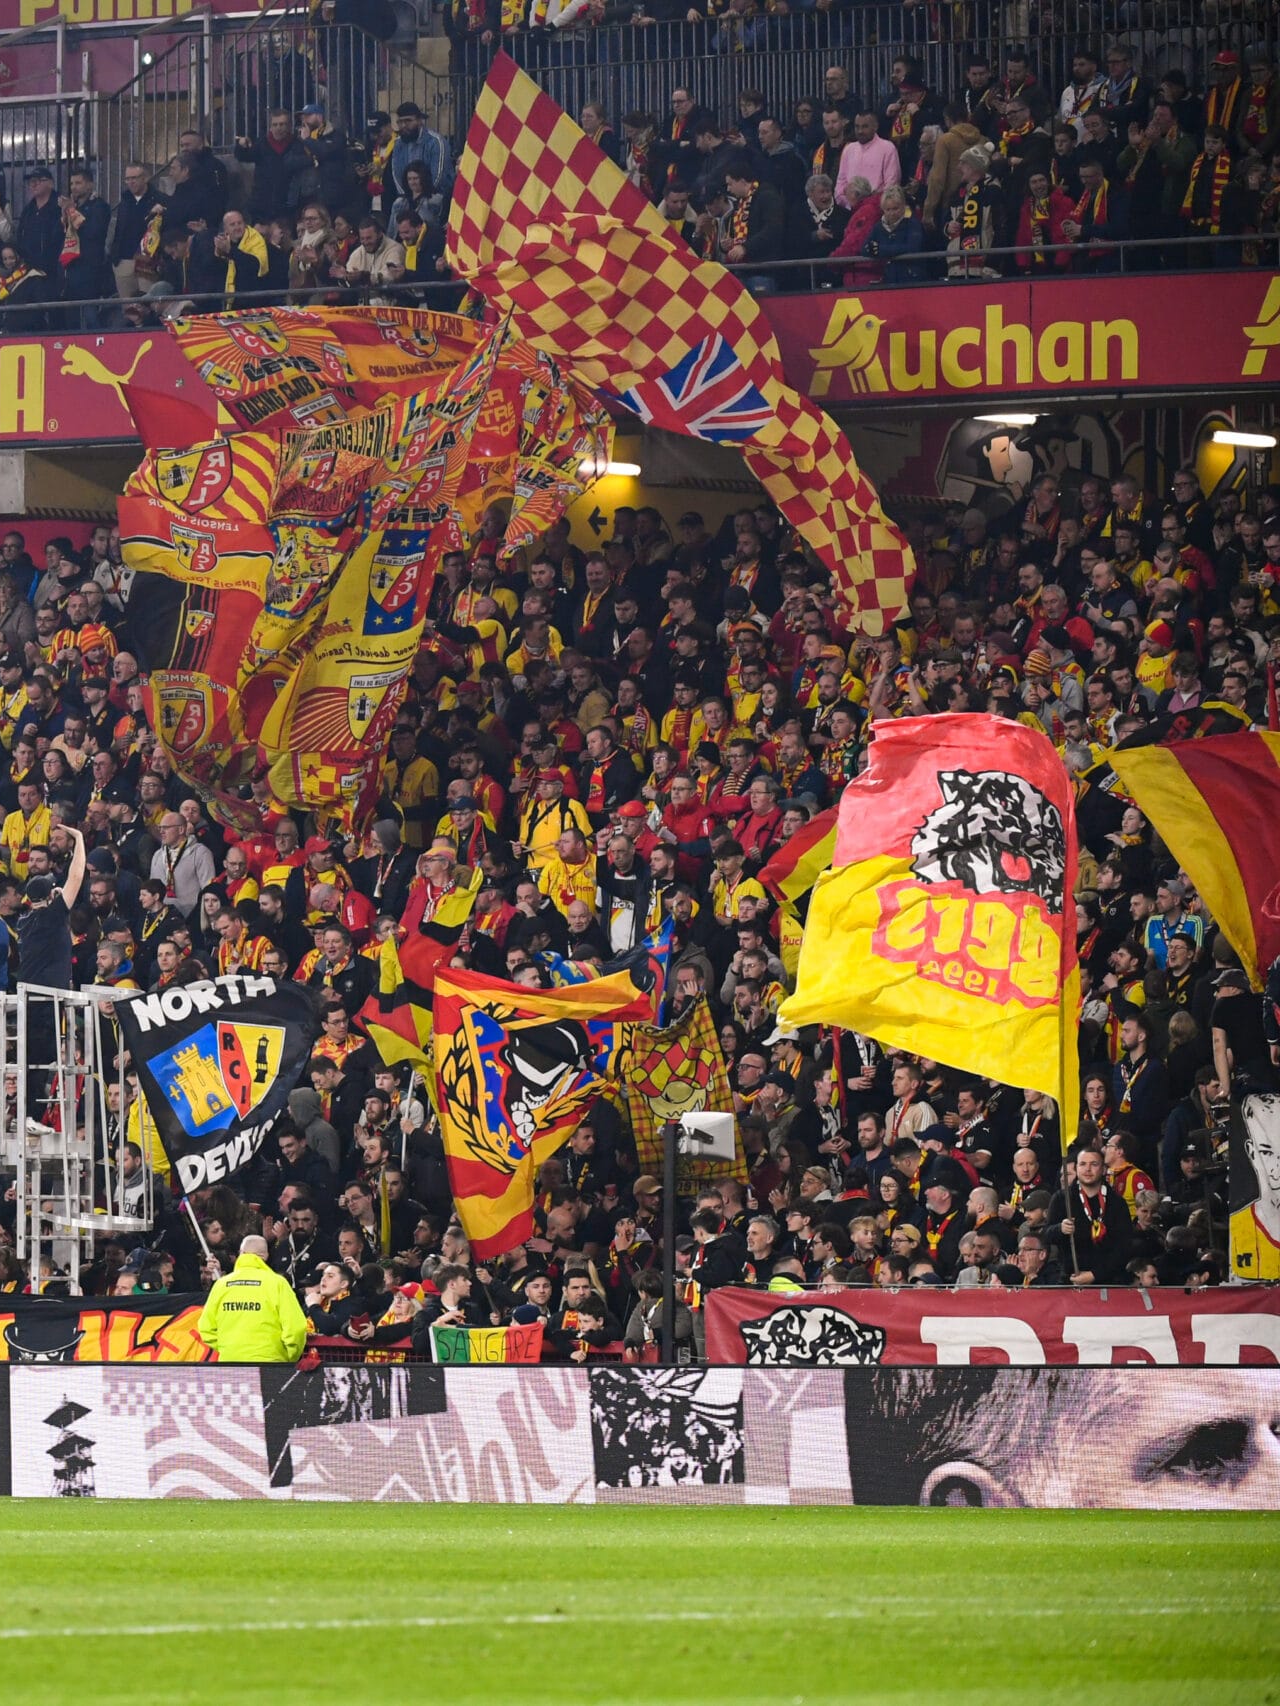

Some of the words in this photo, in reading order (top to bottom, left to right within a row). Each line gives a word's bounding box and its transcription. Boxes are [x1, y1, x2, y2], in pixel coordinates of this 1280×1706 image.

[432, 313, 464, 337] LENS
[232, 327, 274, 356] RCL
[808, 298, 1139, 395] Auchan
[130, 974, 277, 1033] NORTH
[223, 1301, 261, 1312] STEWARD
